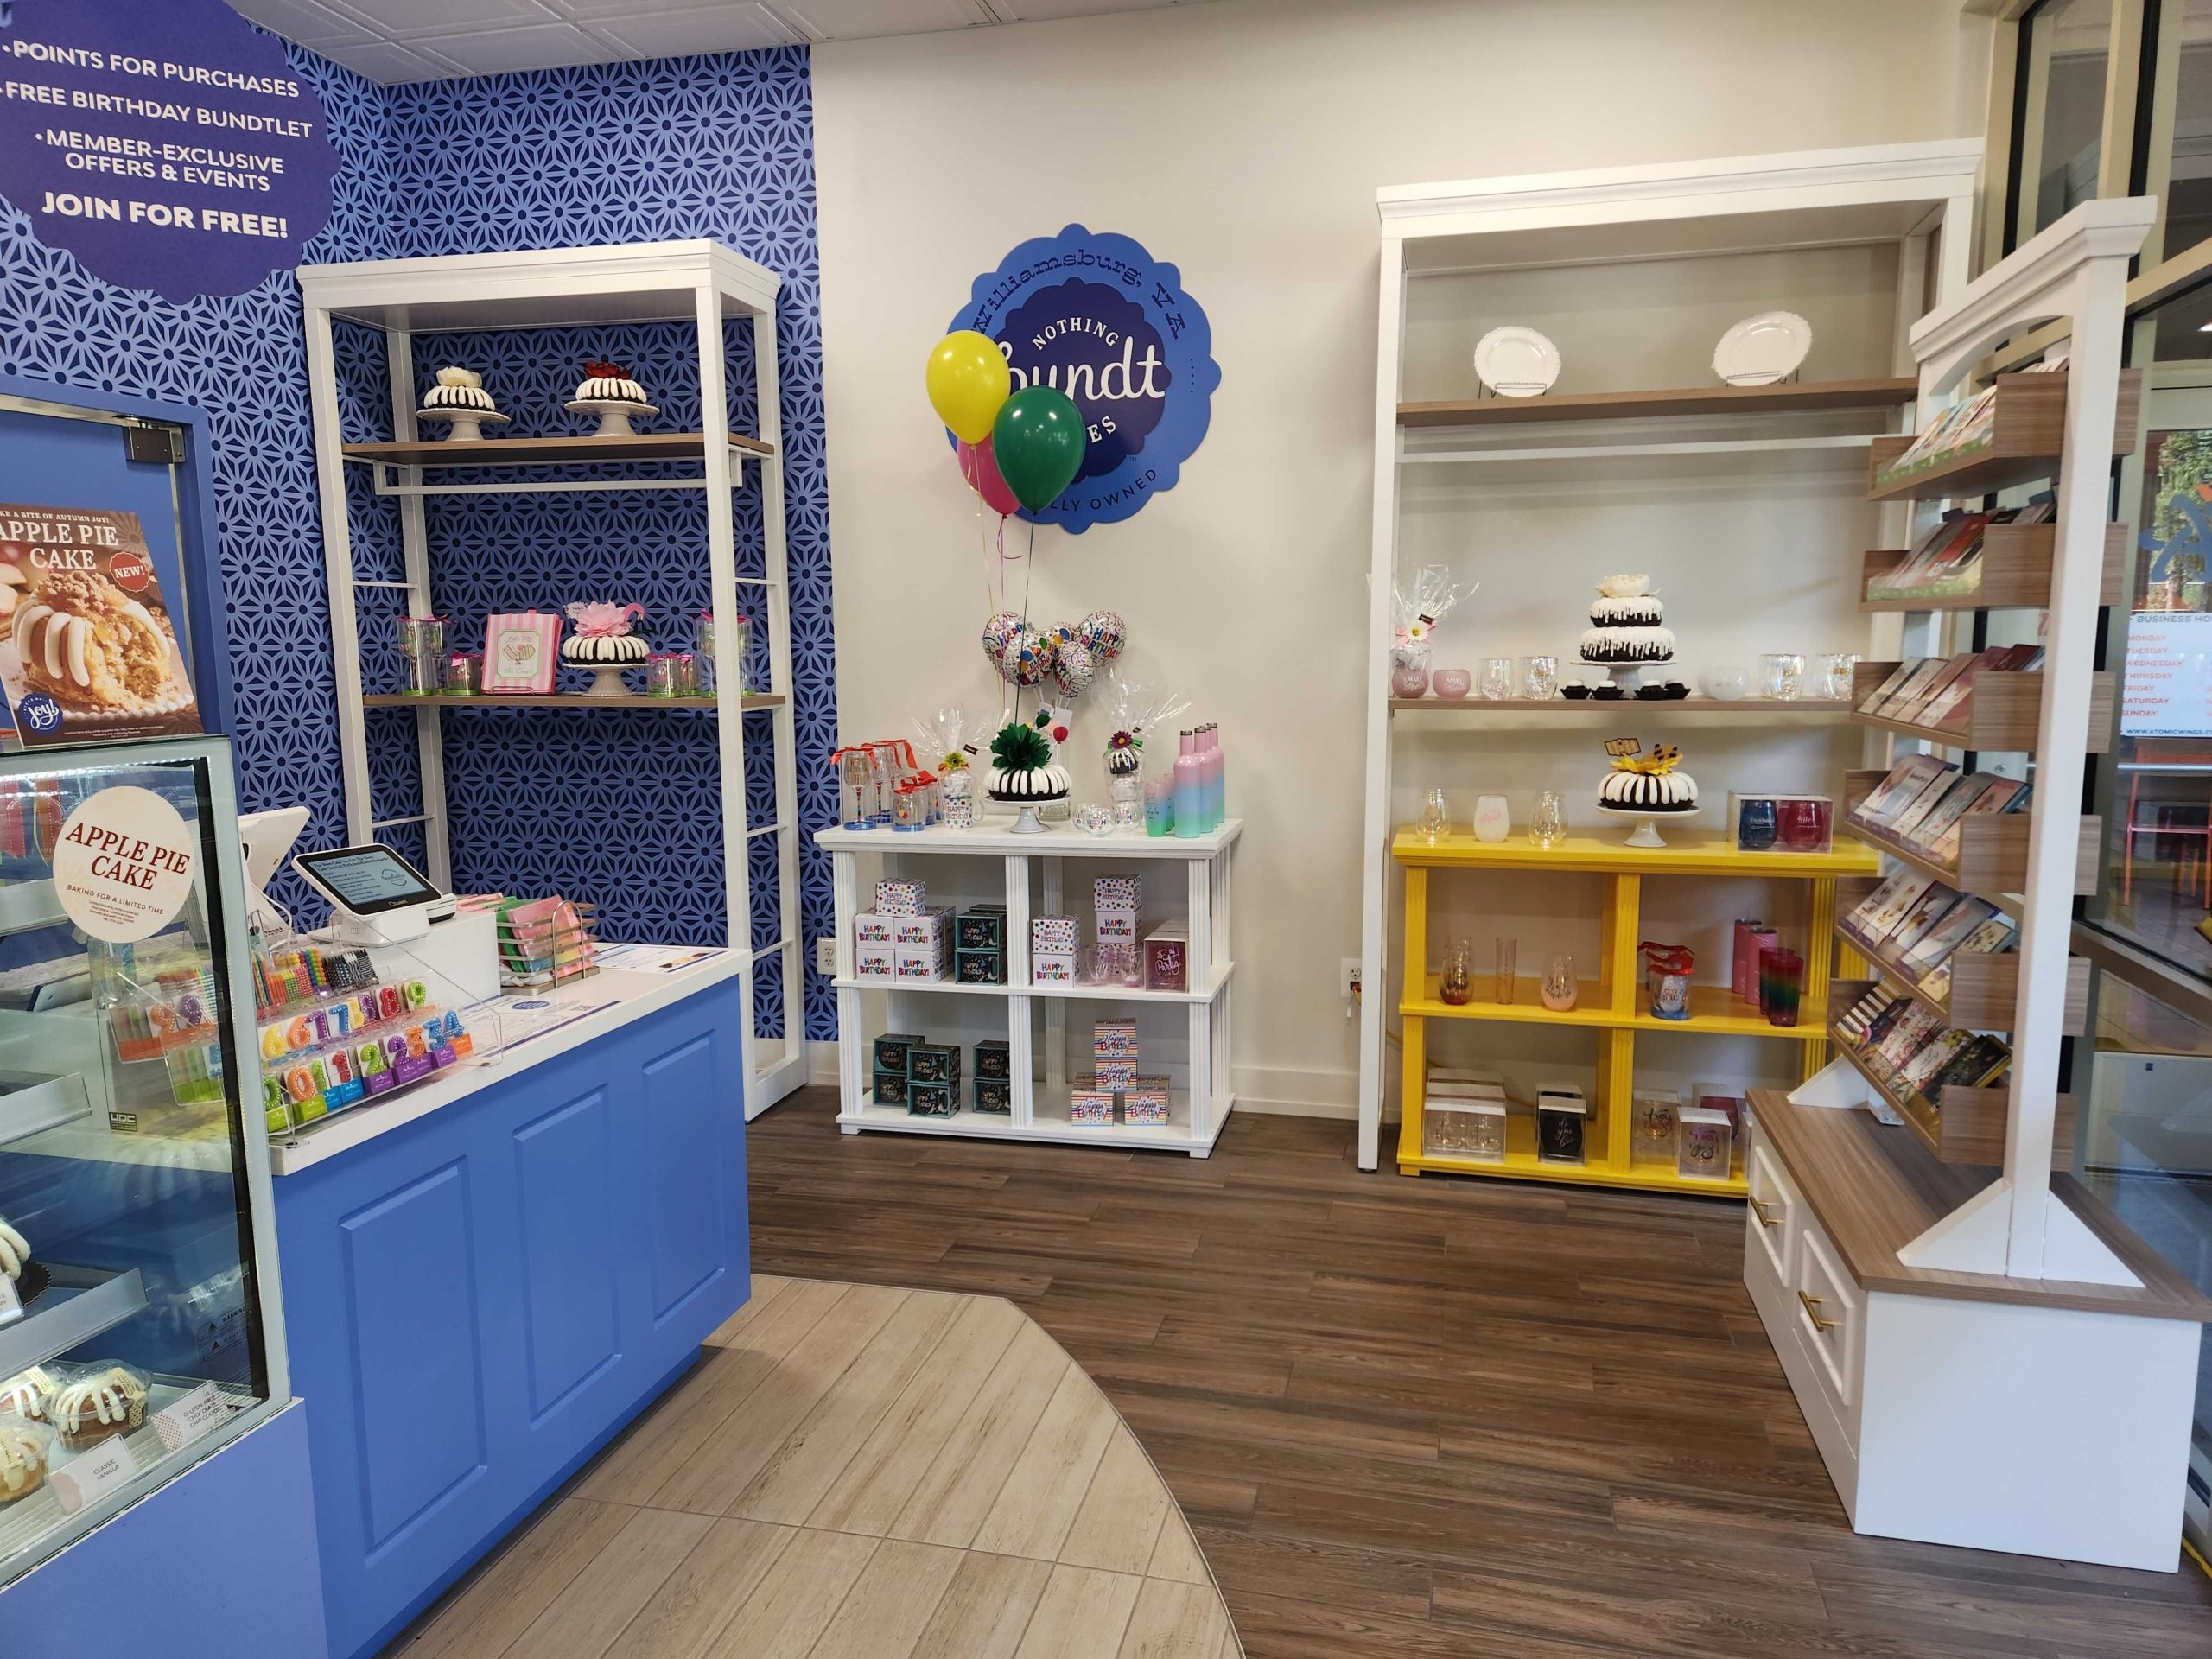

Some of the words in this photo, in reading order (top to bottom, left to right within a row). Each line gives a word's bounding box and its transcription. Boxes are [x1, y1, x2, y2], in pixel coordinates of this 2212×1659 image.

[14, 40, 104, 69] POINTS
[110, 54, 157, 77] FOR
[164, 63, 300, 98] PURCHASES
[6, 81, 67, 105] FREE
[73, 92, 191, 122] BIRTHDAY
[197, 109, 313, 138] BUNDTLET
[47, 129, 284, 174] MEMBER-EXCLUSIVE
[65, 153, 156, 179] OFFERS
[162, 164, 178, 181] &
[184, 168, 270, 192] EVENTS
[41, 192, 121, 221] JOIN
[129, 202, 195, 229] FOR
[202, 209, 288, 238] FREE!
[1151, 283, 1185, 340] VA
[1032, 316, 1119, 351] NOTHING
[1090, 468, 1158, 511] OWNED
[78, 524, 119, 546] PIE
[29, 548, 97, 570] CAKE
[113, 563, 144, 579] NEW!
[66, 823, 149, 861] APPLE
[149, 847, 190, 874] PIE
[92, 856, 157, 890] CAKE
[67, 885, 94, 896] BAKING
[97, 893, 111, 901] FOR
[119, 899, 146, 910] LIMITED
[148, 905, 163, 914] TIME
[859, 933, 890, 942] BIRTHDAY!
[897, 934, 929, 944] BIRTHDAY!
[902, 926, 923, 935] HAPPY
[1100, 926, 1131, 936] BIRTHDAY!
[860, 965, 890, 975] BIRTHDAY!
[864, 957, 885, 966] HAPPY
[898, 968, 929, 976] BIRTHDAY!
[903, 959, 925, 968] HAPPY
[1041, 963, 1063, 972] HAPPY
[1037, 971, 1069, 980] BIRTHDAY!
[330, 1004, 349, 1034] 7
[408, 982, 427, 1009] 9
[360, 1044, 387, 1076] 2
[183, 1402, 203, 1417] GLUTEN
[93, 1459, 117, 1475] CLASSIC
[95, 1465, 119, 1480] VANILLA
